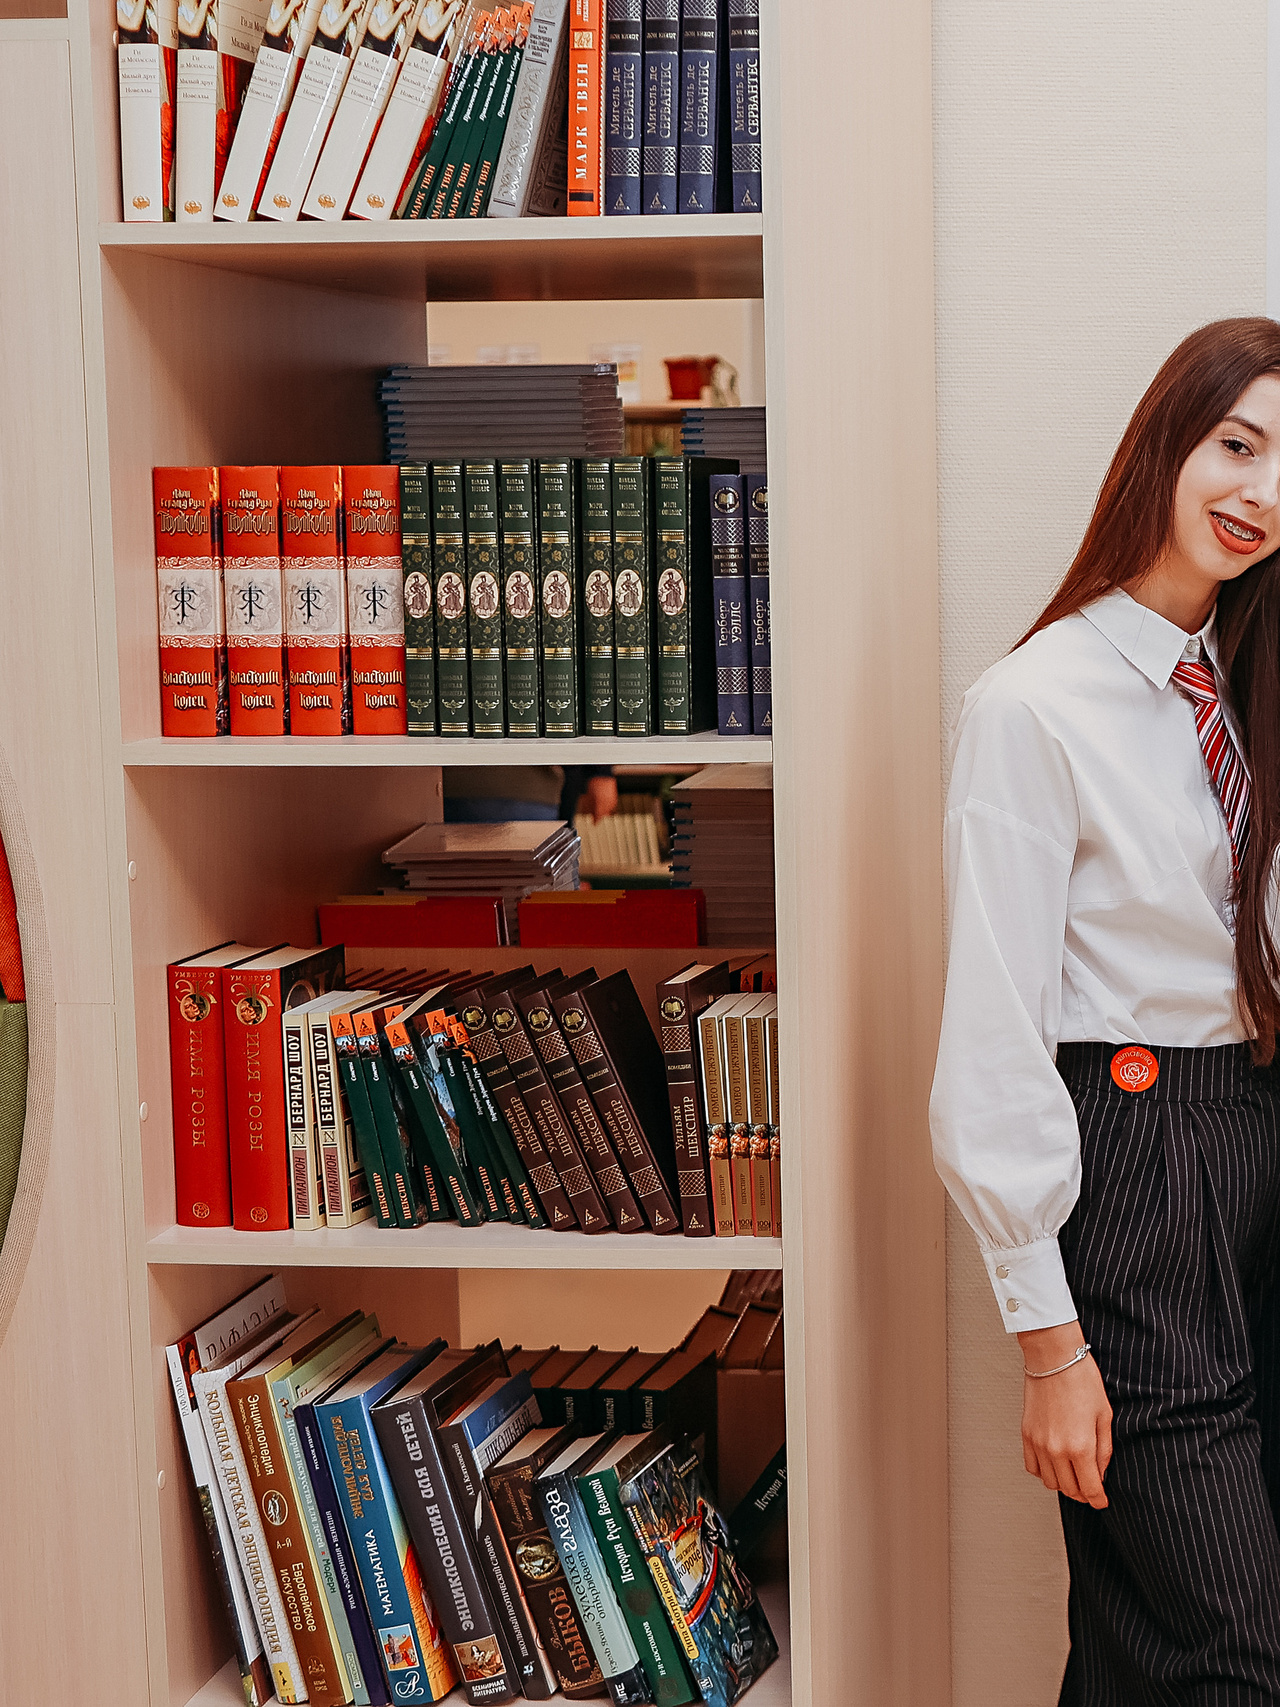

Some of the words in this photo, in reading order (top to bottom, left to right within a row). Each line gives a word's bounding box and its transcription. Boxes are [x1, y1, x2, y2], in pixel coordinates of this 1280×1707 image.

[576, 62, 589, 114] ТВЕН
[612, 66, 620, 82] де
[650, 66, 658, 81] де
[688, 64, 696, 80] де
[736, 63, 744, 78] де
[610, 84, 620, 136] Мигель
[623, 62, 635, 140] СЕРВАНТЕС
[646, 84, 658, 134] Мигель
[660, 62, 672, 138] СЕРВАНТЕС
[684, 82, 695, 132] Мигель
[697, 60, 710, 138] СЕРВАНТЕС
[734, 82, 744, 132] Мигель
[747, 58, 760, 136] СЕРВАНТЕС
[575, 125, 588, 180] МАРК
[410, 191, 426, 220] МАРК
[421, 164, 436, 190] ТВЕН
[431, 190, 446, 220] МАРК
[440, 163, 456, 188] ТВЕН
[447, 190, 462, 219] МАРК
[457, 162, 472, 188] ТВЕН
[469, 188, 484, 218] МАРК
[478, 160, 492, 186] ТВЕН
[717, 598, 730, 647] Герберт
[730, 602, 742, 644] УЭЛЛС
[754, 598, 767, 646] Герберт
[162, 669, 214, 686] Властелин
[230, 669, 280, 686] Властелин
[290, 669, 338, 686] Властелин
[353, 669, 404, 686] Властелин
[190, 1028, 204, 1078] ИМЯ
[246, 1032, 260, 1082] ИМЯ
[288, 1034, 300, 1062] ШОУ
[314, 1032, 328, 1060] ШОУ
[704, 1022, 718, 1076] ДЖУЛЬЕТТА
[730, 1021, 740, 1076] ДЖУЛЬЕТТА
[750, 1022, 762, 1076] ДЖУЛЬЕТТА
[192, 1087, 206, 1148] РОЗЫ
[290, 1066, 304, 1124] БЕРНАРД
[318, 1063, 334, 1122] БЕРНАРД
[708, 1088, 720, 1118] РОМЕО
[732, 1086, 742, 1116] РОМЕО
[754, 1086, 762, 1118] РОМЕО
[248, 1091, 264, 1152] РОЗЫ
[510, 1096, 542, 1154] ШЕКСПИР
[540, 1098, 573, 1157] ШЕКСПИР
[576, 1098, 609, 1156] ШЕКСПИР
[610, 1099, 644, 1158] ШЕКСПИР
[683, 1096, 699, 1158] ШЕКСПИР
[295, 1156, 308, 1214] ПИГМАЛИОН
[326, 1154, 340, 1212] ПИГМАЛИОН
[372, 1172, 390, 1220] ШЕКСПИР
[394, 1172, 412, 1220] ШЕКСПИР
[424, 1164, 440, 1212] ШЕКСПИР
[448, 1176, 472, 1220] ШЕКСПИР
[478, 1166, 498, 1212] ШЕКСПИР
[177, 1376, 190, 1418] РАФАЭЛЬ
[248, 1394, 275, 1476] Энциклопедия
[344, 1428, 368, 1470] ДЕТЕЙ
[395, 1410, 424, 1462] ДЕТЕЙ
[330, 1415, 364, 1520] ЭНЦИКЛОПЕДИЯ
[358, 1474, 375, 1502] ДЛЯ
[414, 1466, 436, 1500] ДЛЯ
[204, 1390, 234, 1462] БОЛЬШАЯ
[221, 1466, 252, 1530] ДЕТСКАЯ
[242, 1534, 282, 1654] ЭНЦИКЛОПЕДИЯ
[286, 1420, 301, 1461] История
[298, 1460, 312, 1500] искусства
[306, 1500, 317, 1522] для
[312, 1522, 324, 1548] детей
[322, 1558, 336, 1594] Модерн
[326, 1510, 338, 1542] ВЕНЕЦИЯ
[545, 1488, 578, 1552] глаза
[604, 1518, 622, 1542] Руси
[334, 1547, 351, 1590] ФЛОРЕНЦИЯ
[364, 1528, 394, 1616] МАТЕМАТИКА
[425, 1503, 475, 1633] ЭНЦИКЛОПЕДИЯ
[484, 1535, 498, 1566] СЛОВАРЬ
[614, 1542, 635, 1584] История
[292, 1562, 316, 1632] Европейское
[493, 1565, 517, 1616] ПОЭТИЧЕСКИЙ
[564, 1553, 596, 1623] Зулейха
[578, 1551, 606, 1619] открывает
[652, 1561, 674, 1600] короче
[510, 1616, 529, 1657] ШКОЛЬНЫЙ
[548, 1586, 591, 1673] БЫКОВ
[595, 1620, 608, 1646] Яхина
[642, 1620, 661, 1662] КОСТОМАРОВ
[668, 1600, 686, 1632] смотри
[604, 1645, 618, 1674] Гузель
[682, 1630, 696, 1654] Типа
[472, 1678, 505, 1692] ВСЕМИРНАЯ
[473, 1684, 507, 1698] ЛИТЕРАТУРА
